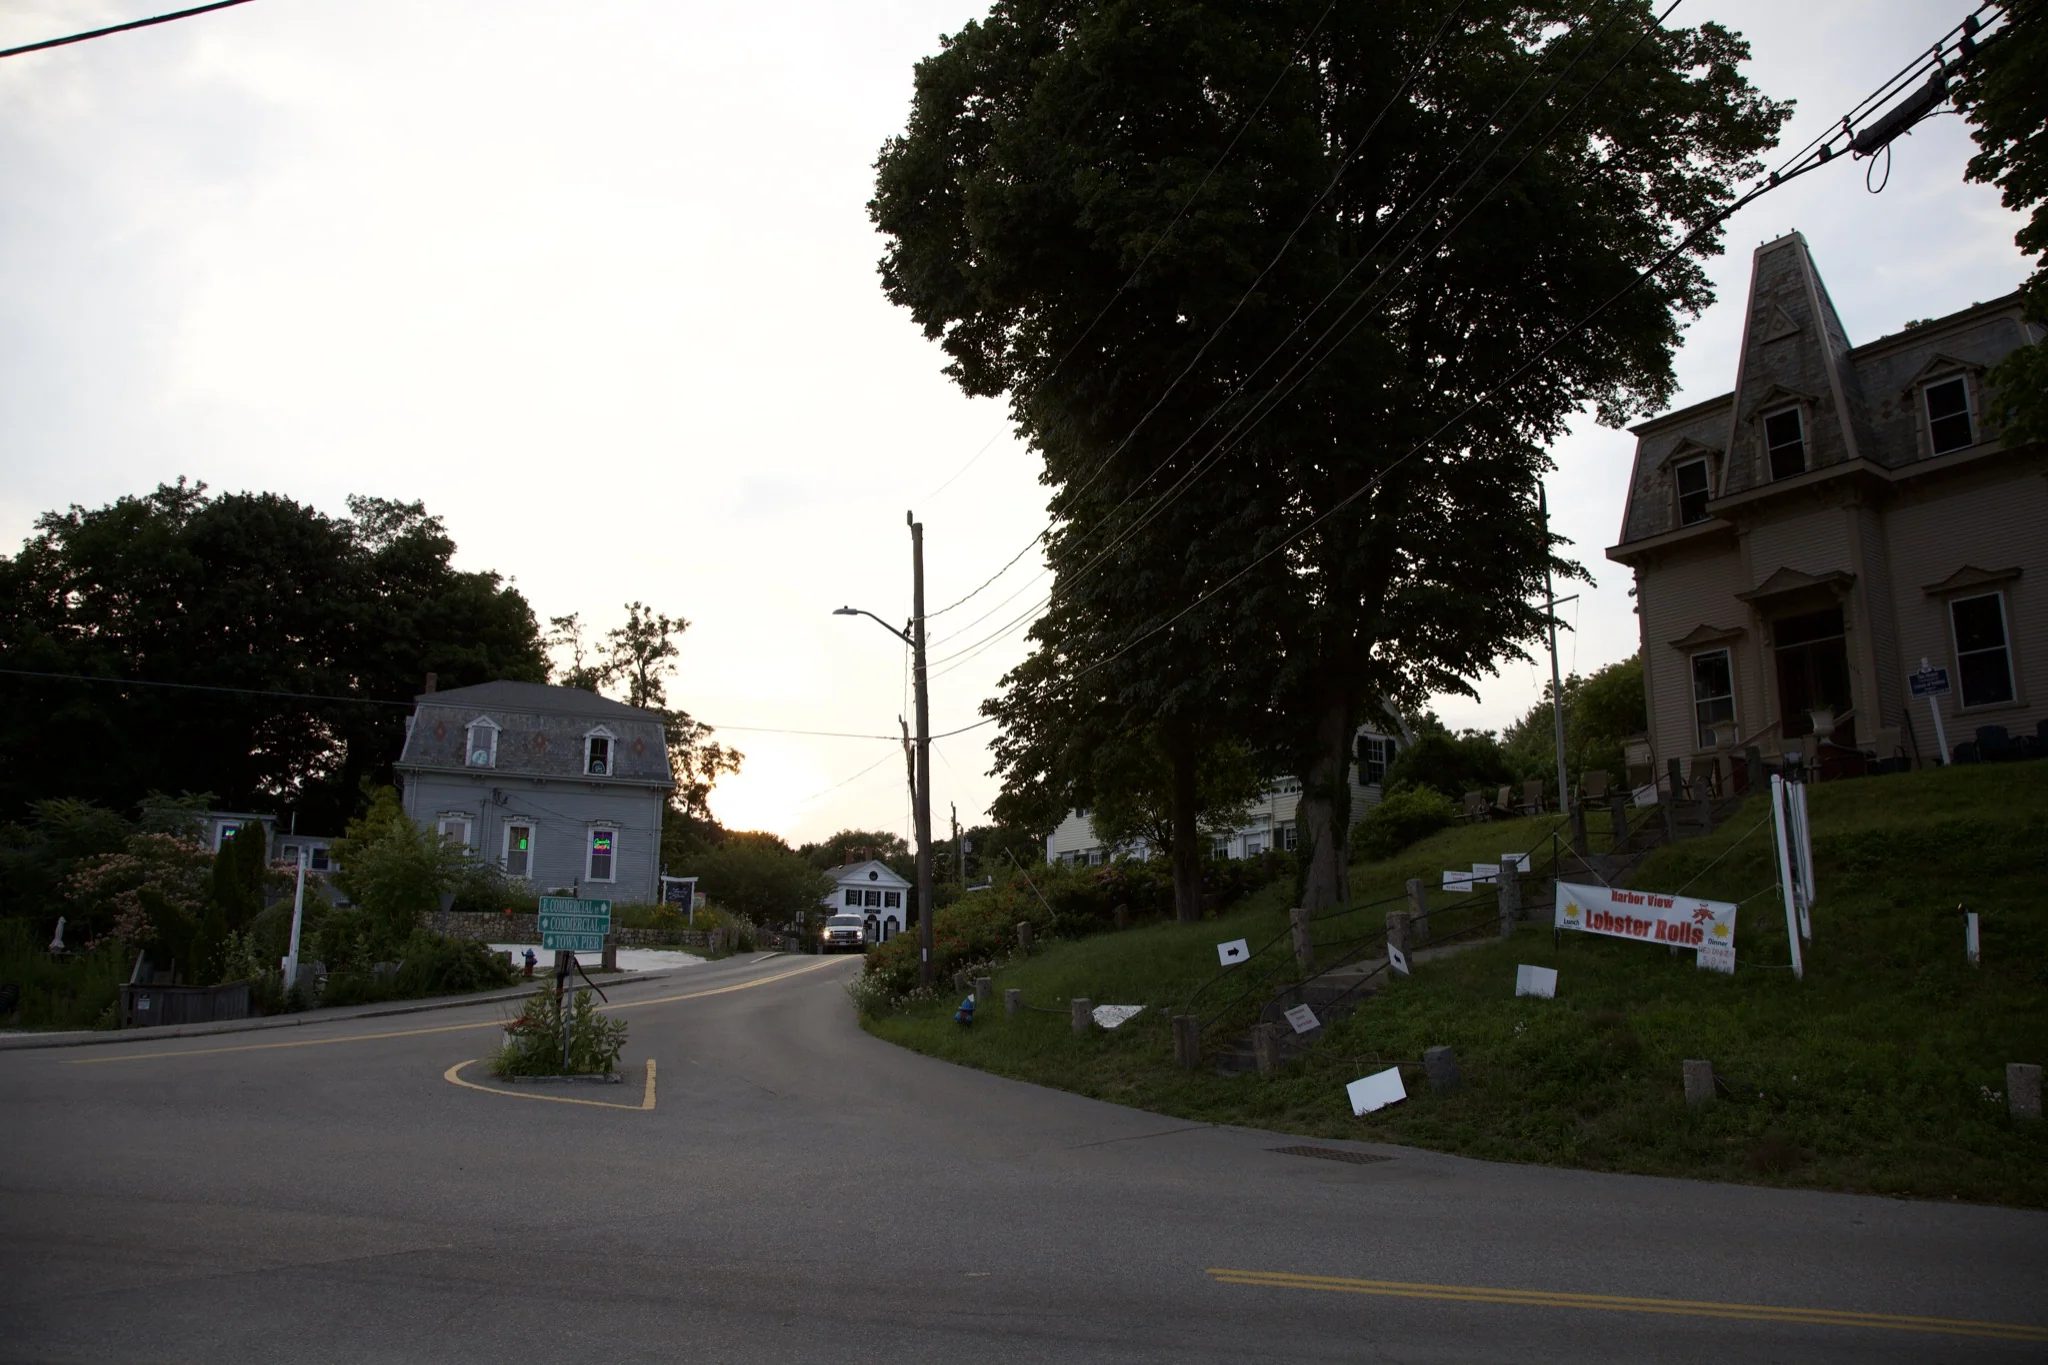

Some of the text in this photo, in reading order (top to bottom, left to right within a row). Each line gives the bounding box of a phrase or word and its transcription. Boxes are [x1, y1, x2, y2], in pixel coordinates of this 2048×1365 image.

[549, 899, 593, 914] COMMERCIAL
[1611, 889, 1674, 909] Harbor View
[550, 917, 599, 932] COMMERCIAL
[1563, 918, 1580, 926] Lunch
[1586, 909, 1704, 946] Lobster Rolls
[556, 935, 600, 950] TOWN PIER
[1708, 938, 1728, 947] Dinner
